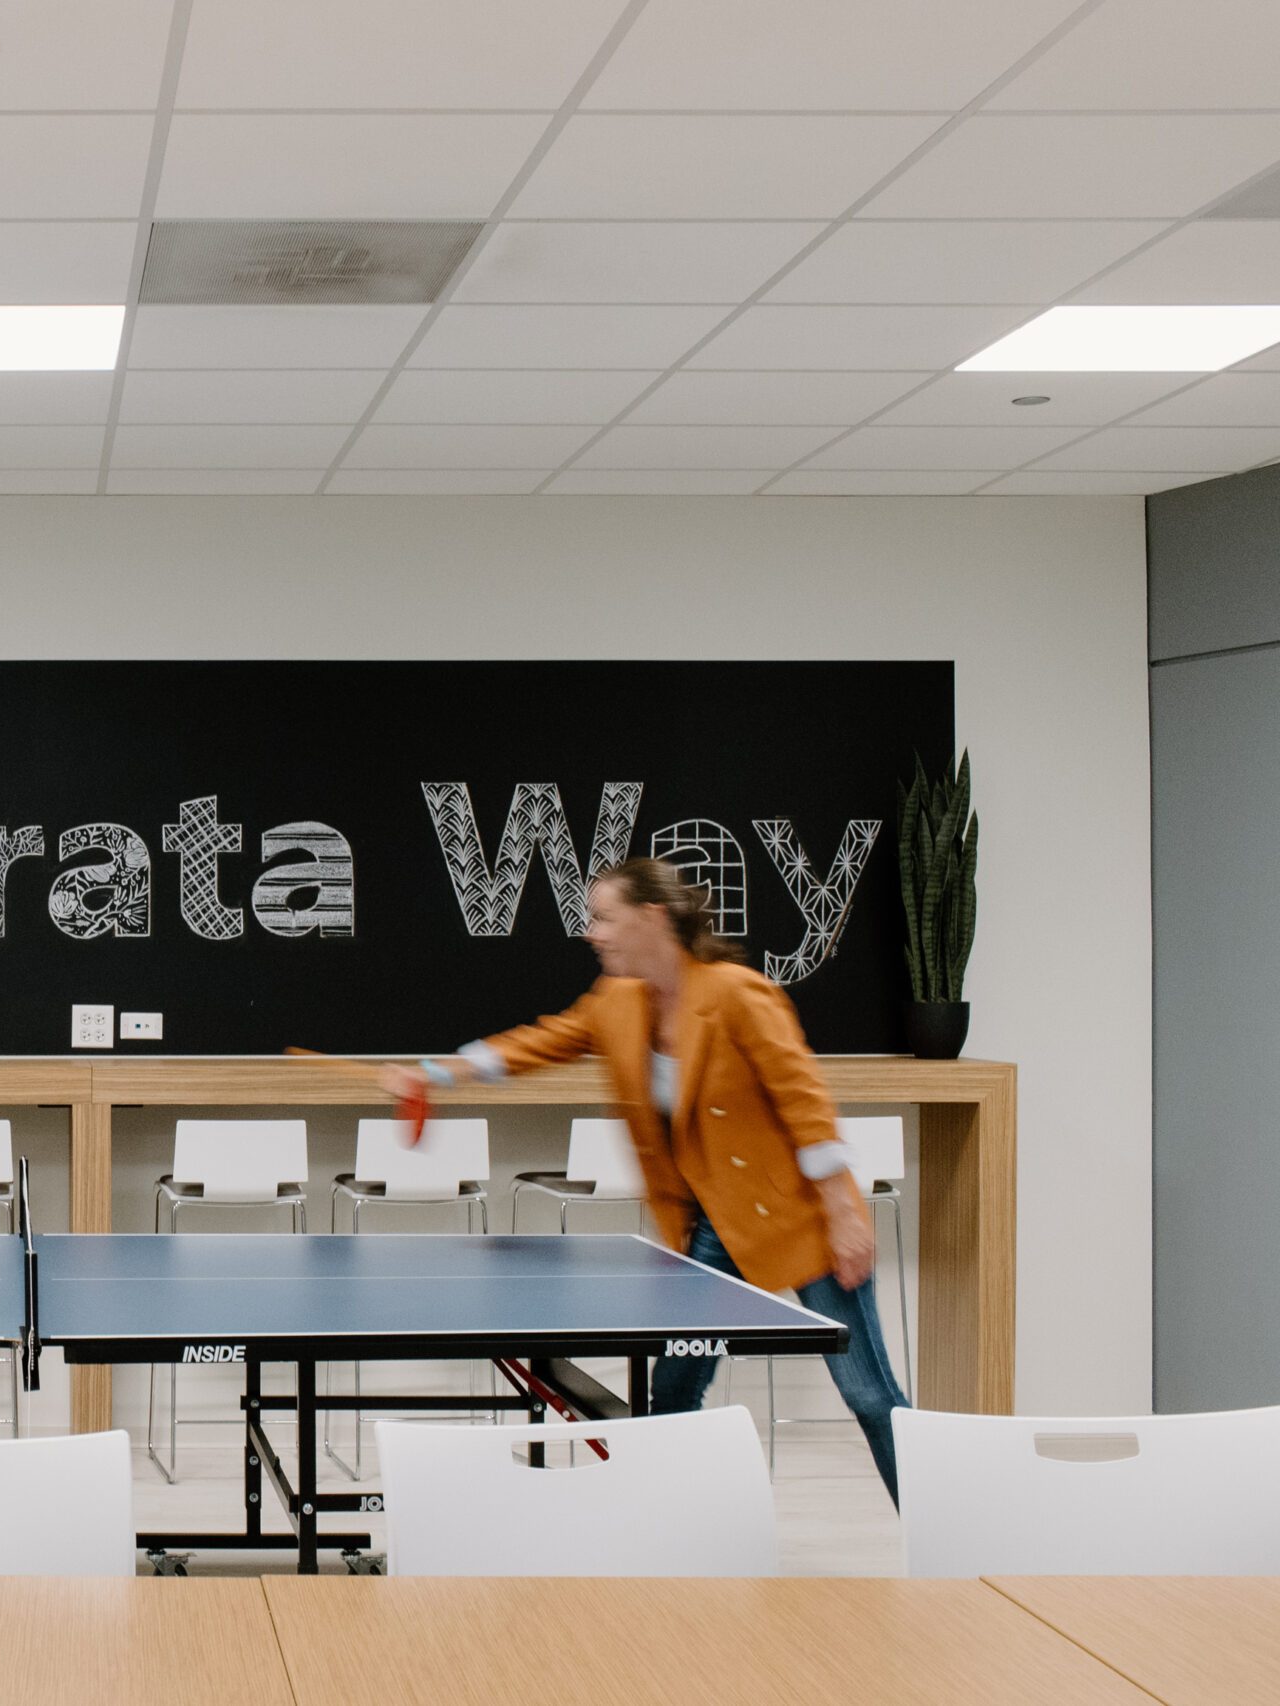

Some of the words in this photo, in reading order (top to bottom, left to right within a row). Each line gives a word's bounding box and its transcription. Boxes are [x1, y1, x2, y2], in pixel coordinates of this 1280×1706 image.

[421, 781, 883, 986] Way
[182, 1345, 246, 1363] INSIDE
[665, 1339, 729, 1356] JOOLA
